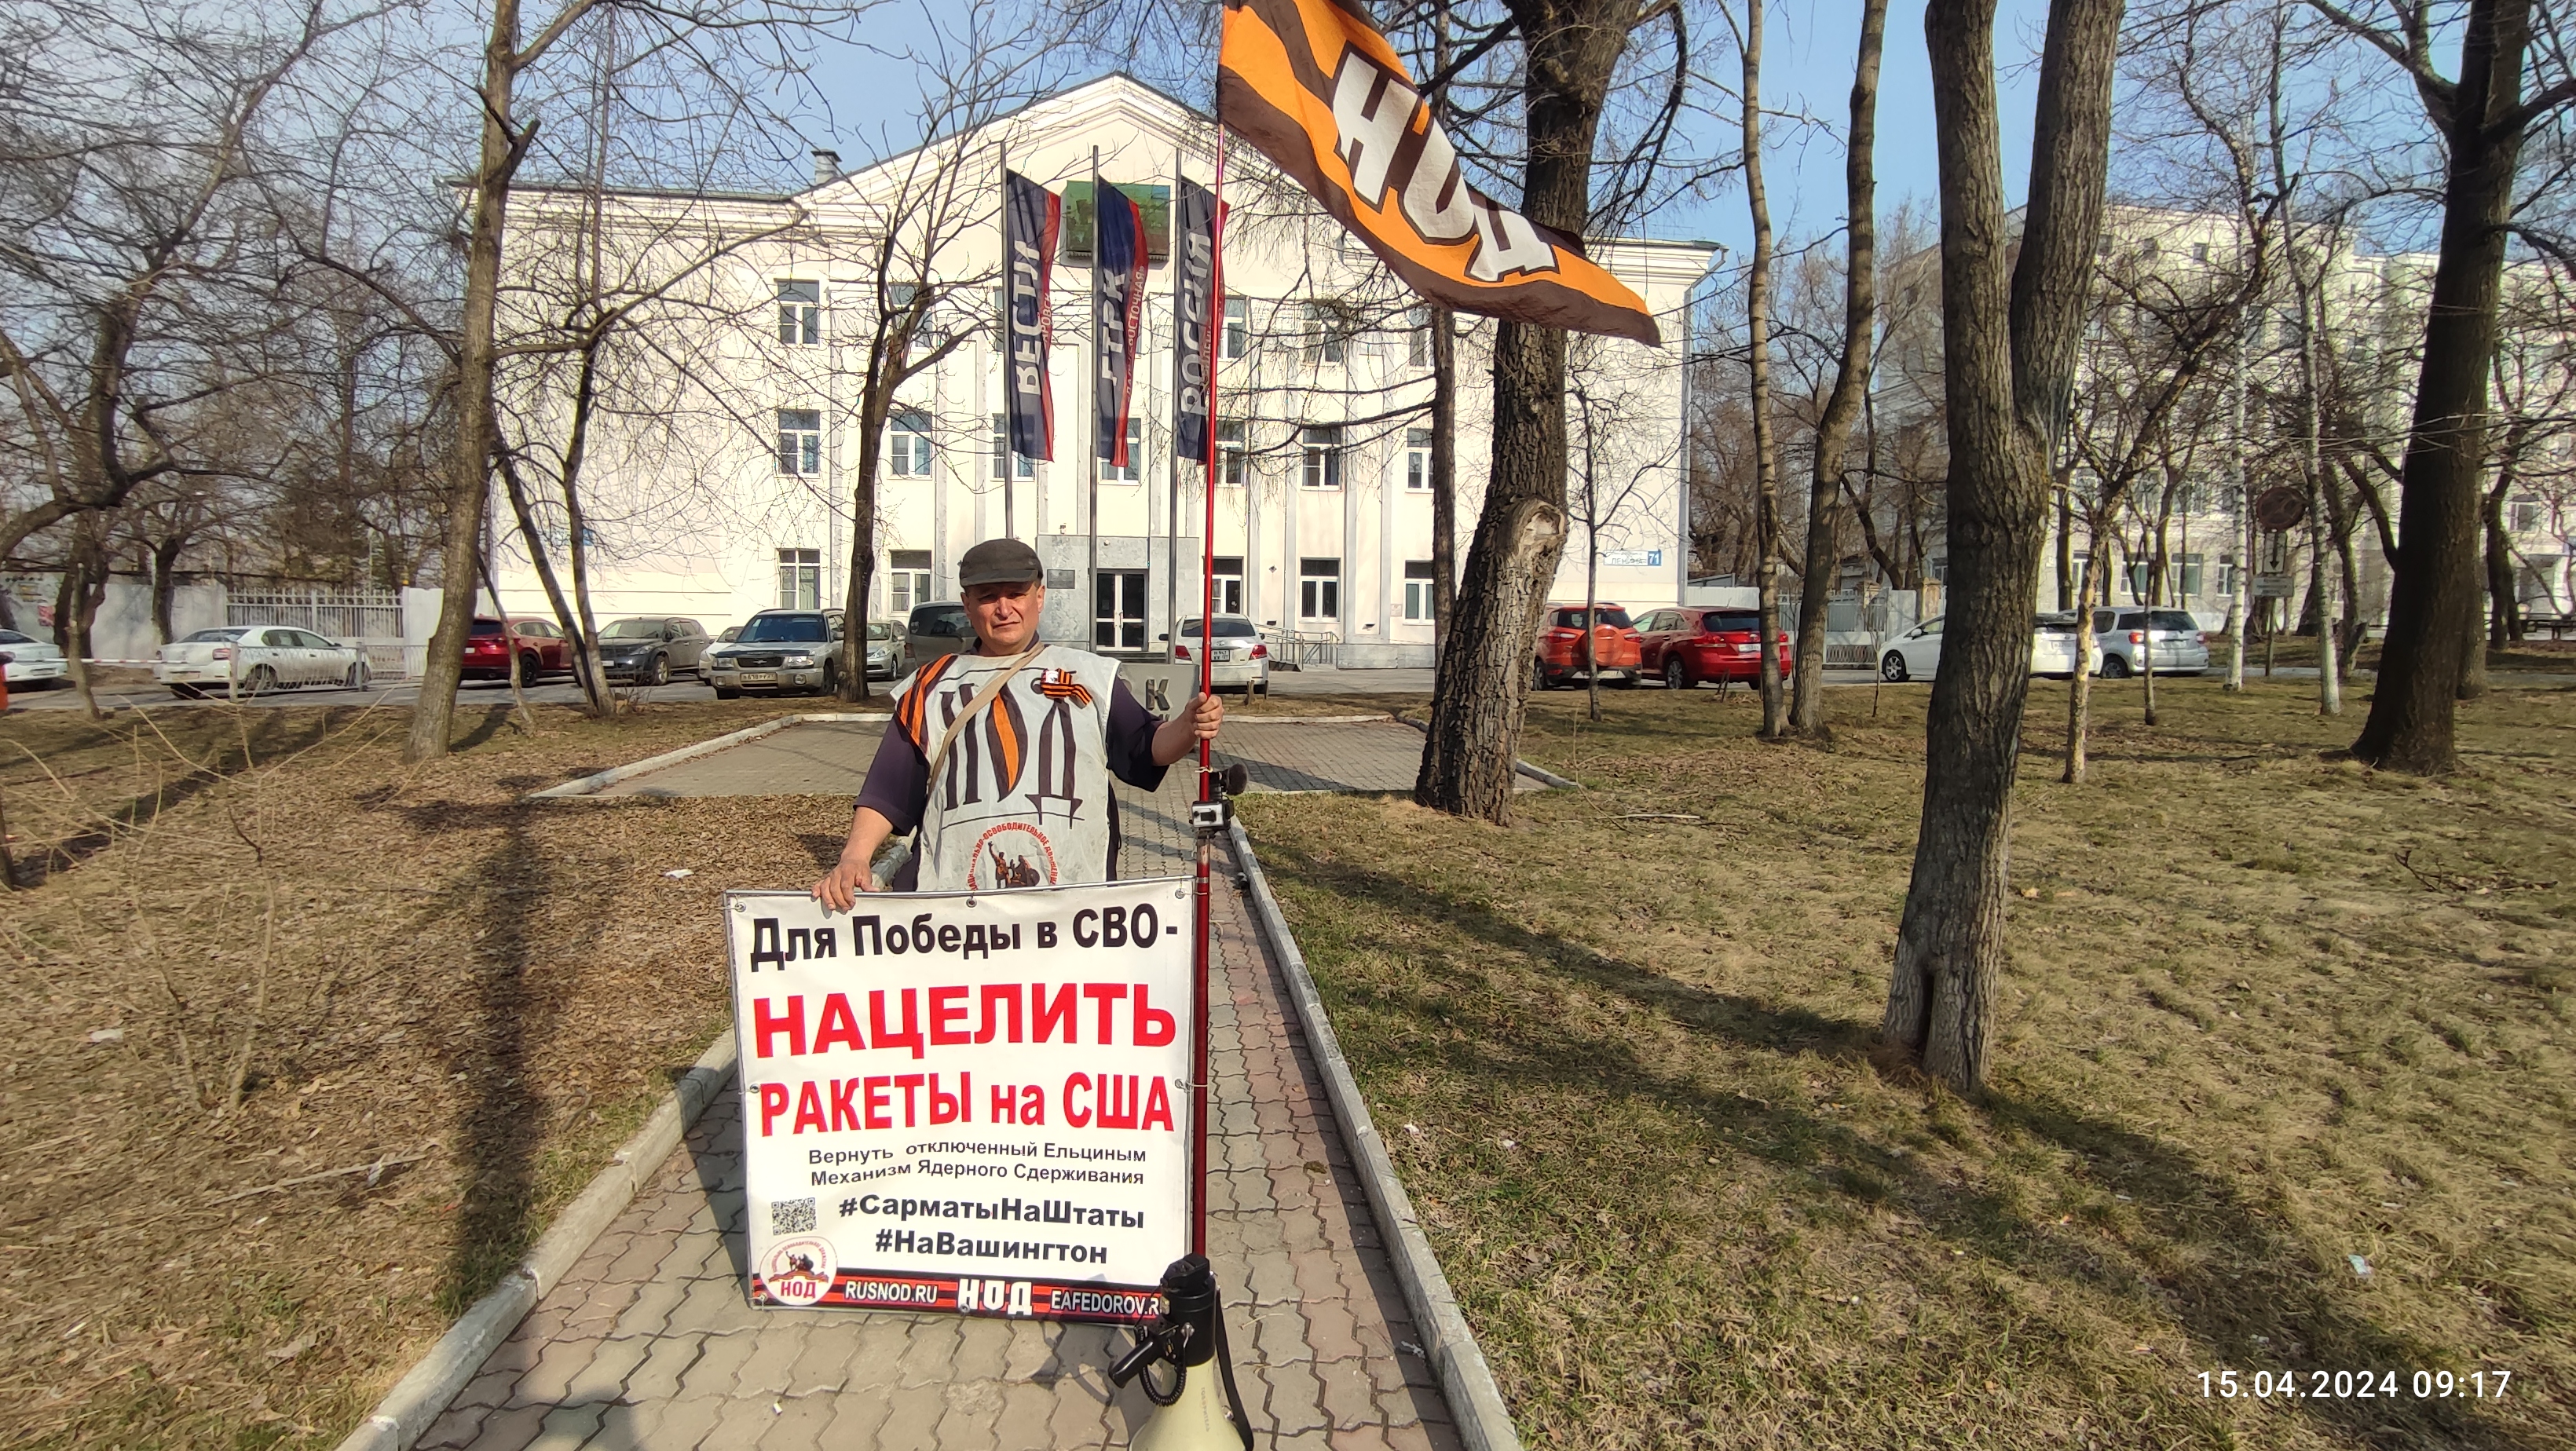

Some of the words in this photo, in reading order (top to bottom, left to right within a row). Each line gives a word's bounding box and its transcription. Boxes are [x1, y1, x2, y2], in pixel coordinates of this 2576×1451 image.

[1333, 52, 1558, 282] НОД
[1013, 239, 1042, 397] ВЕСТИ
[1102, 268, 1127, 386] ГТРК
[1180, 232, 1212, 416] РОССИЯ
[1648, 553, 1659, 565] 71
[750, 918, 837, 972] Для
[852, 913, 1022, 960] Победы
[1037, 922, 1058, 948] в
[754, 982, 1177, 1059] НАЦЕЛИТЬ
[760, 1071, 971, 1137] РАКЕТЫ
[991, 1084, 1045, 1126] на
[1063, 1072, 1175, 1132] США
[809, 1148, 894, 1165] Вернуть
[906, 1141, 1037, 1157] отключенный
[1044, 1142, 1147, 1162] Ельциным
[811, 1163, 911, 1186] Механизм
[917, 1159, 1008, 1179] Ядерного
[1014, 1163, 1144, 1184] Сдерживания
[839, 1193, 1145, 1230] #СарматыНаШтаты
[875, 1229, 1108, 1265] #НаВашингтон
[780, 1281, 816, 1299] НОД
[844, 1281, 938, 1304] RUSNOD.RU
[957, 1279, 1033, 1316] НОД
[1050, 1291, 1160, 1316] EAFEDOROV.R
